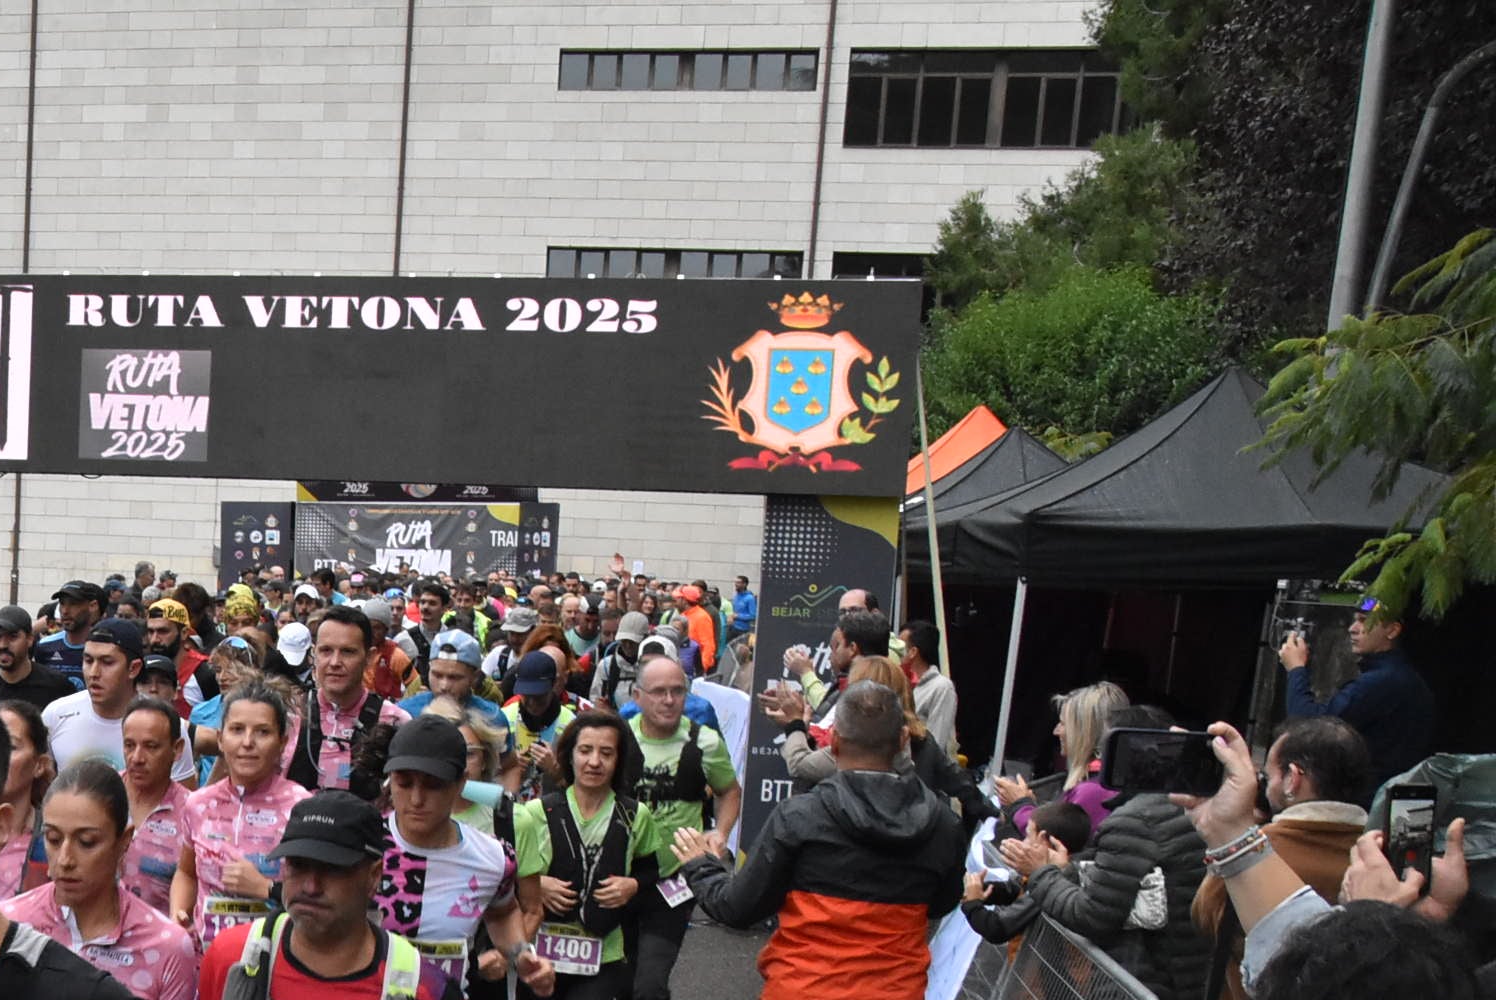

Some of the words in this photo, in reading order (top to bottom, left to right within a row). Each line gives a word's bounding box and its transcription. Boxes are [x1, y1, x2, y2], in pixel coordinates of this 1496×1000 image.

[66, 294, 225, 328] RUTA
[242, 295, 486, 331] VETONA
[505, 297, 659, 334] 2025
[106, 350, 181, 395] RUTA
[88, 392, 210, 433] VETONA
[101, 431, 186, 461] 2025
[386, 520, 432, 549] RUTA
[489, 530, 519, 548] TRAI
[761, 779, 794, 803] BTT
[544, 935, 592, 961] 1400
